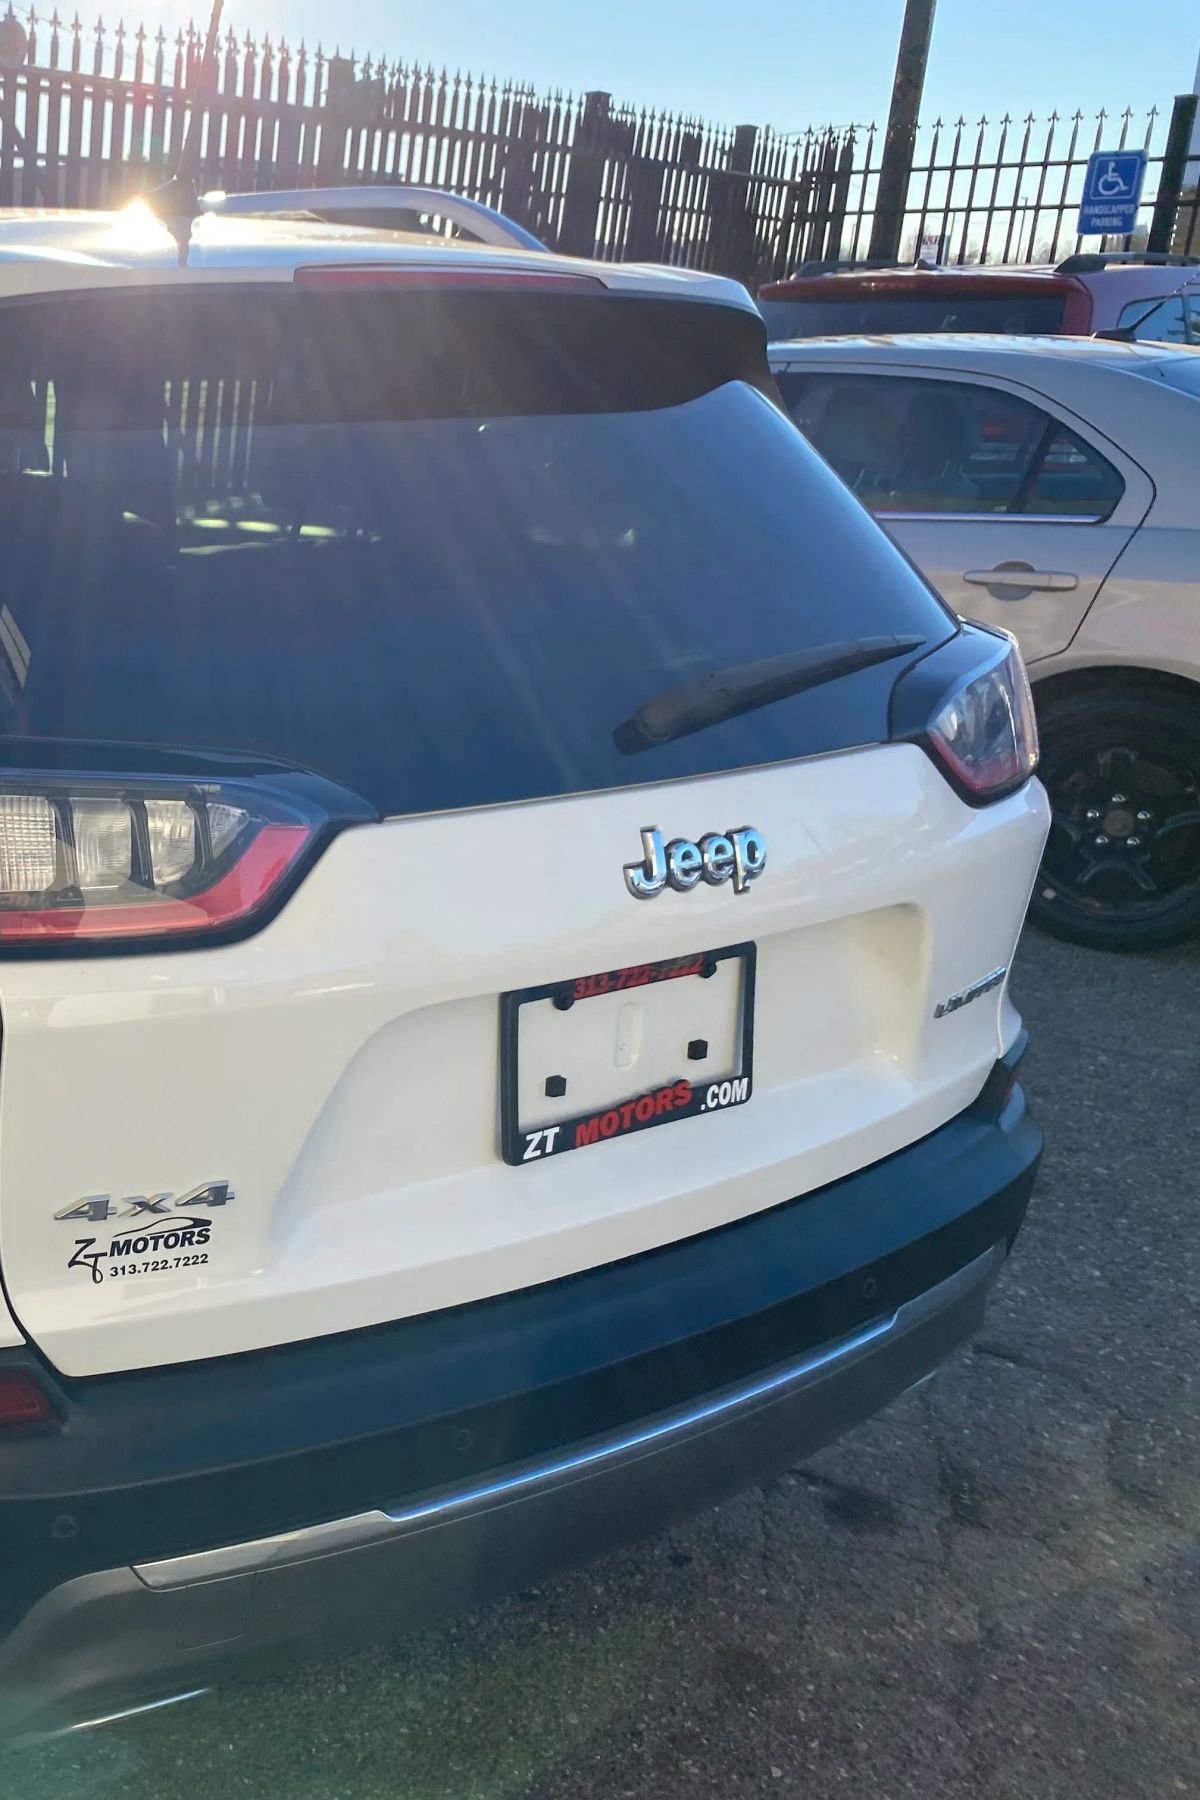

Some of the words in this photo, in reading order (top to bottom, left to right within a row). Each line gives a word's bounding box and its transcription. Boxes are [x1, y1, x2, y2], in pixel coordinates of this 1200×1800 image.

[623, 825, 766, 900] Jeep
[522, 1127, 560, 1160] ZT
[574, 1079, 693, 1150] MOTORS
[700, 1077, 749, 1111] .COM
[109, 1227, 211, 1258] MOTORS
[109, 1253, 209, 1277] 313.722.7222
